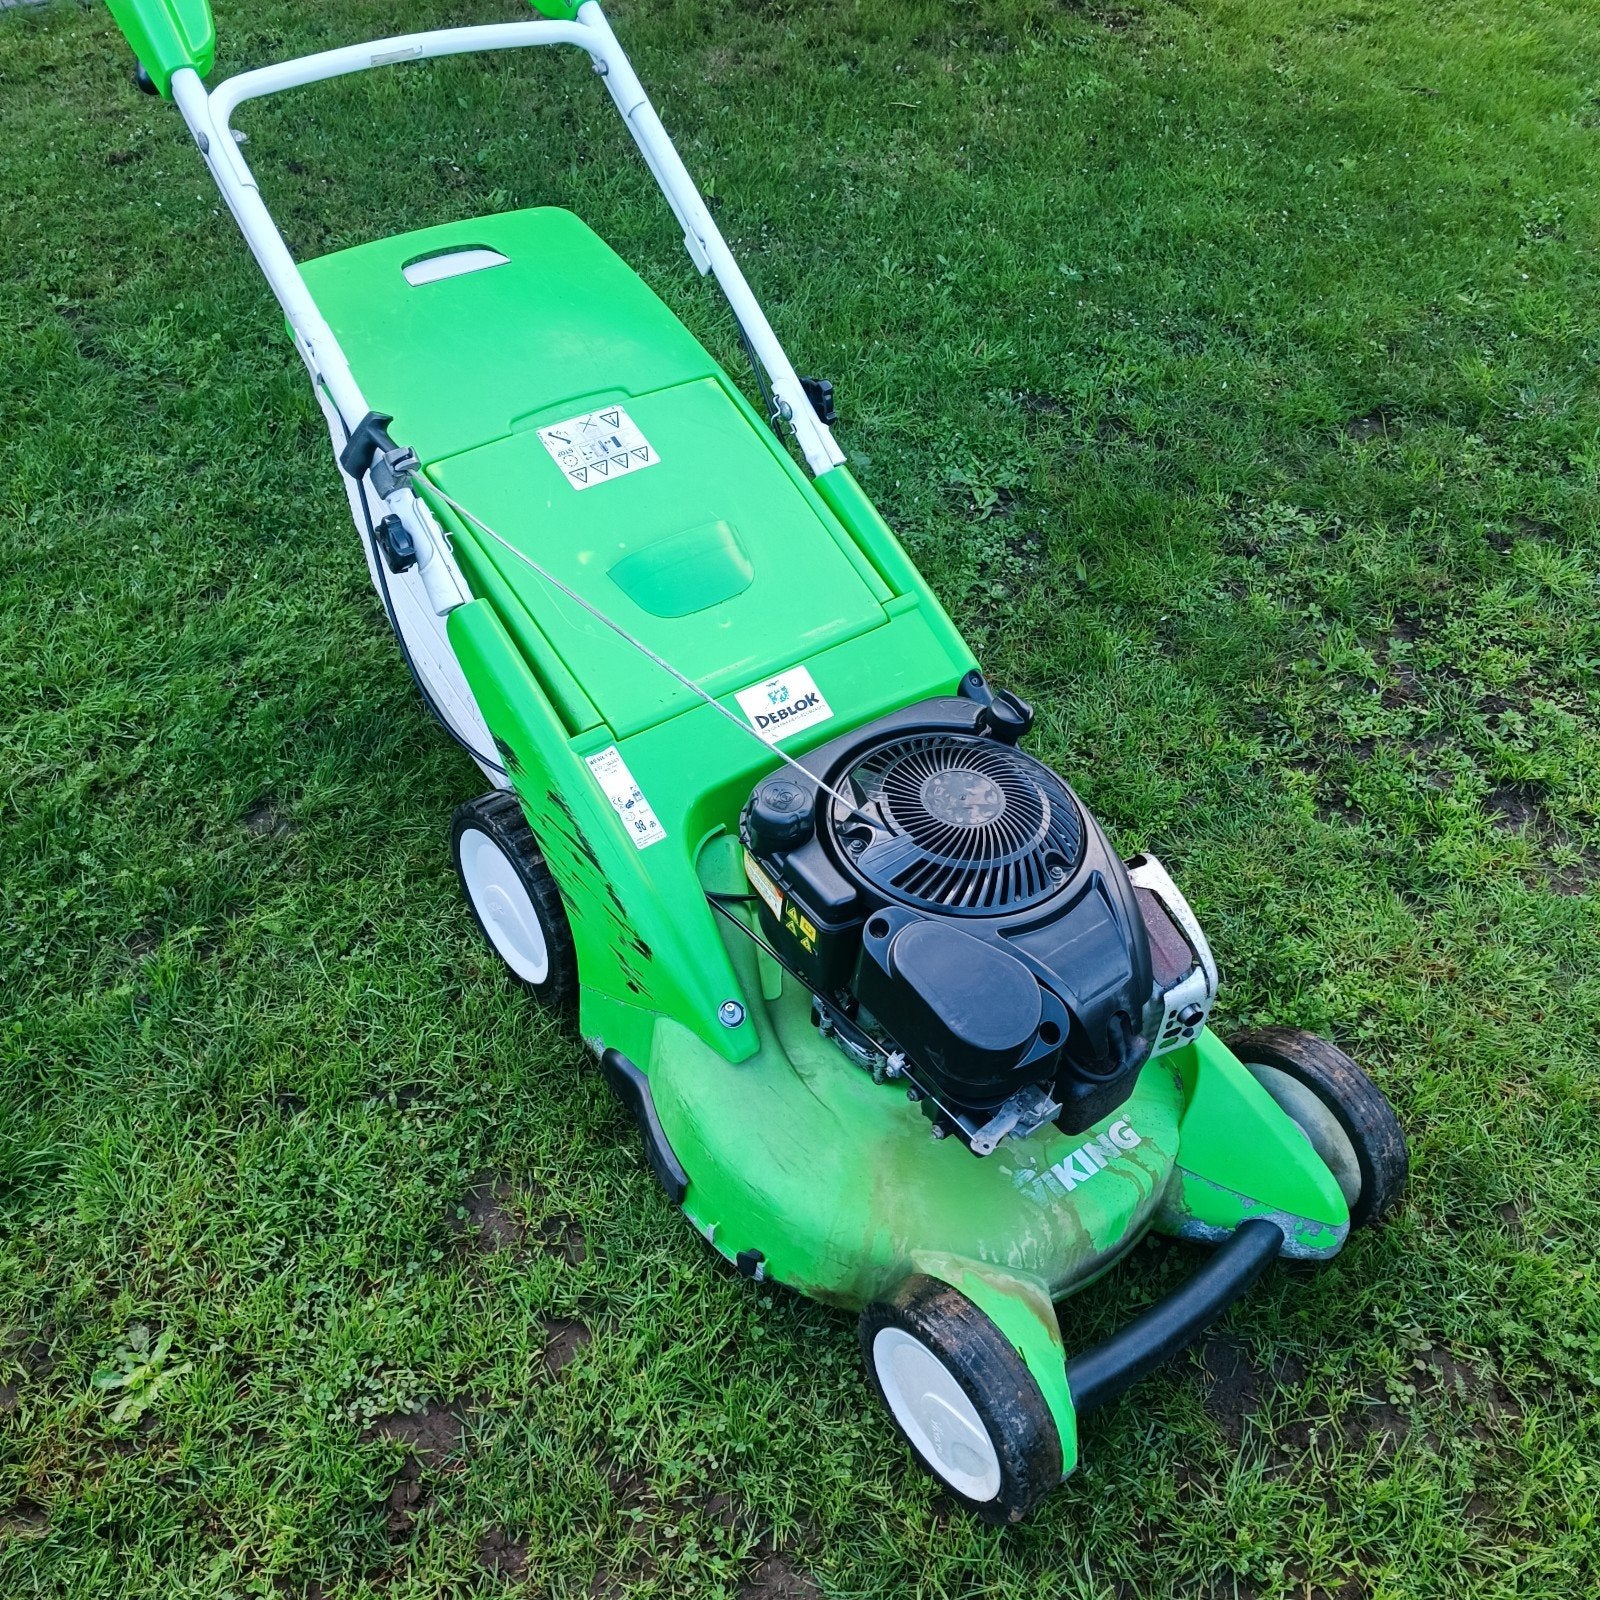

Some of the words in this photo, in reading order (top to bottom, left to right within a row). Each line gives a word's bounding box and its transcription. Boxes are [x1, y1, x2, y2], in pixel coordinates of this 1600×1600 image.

[557, 448, 574, 458] STOP
[754, 692, 820, 729] DEBLOK
[634, 819, 647, 833] 98
[1020, 1120, 1142, 1210] VIKING
